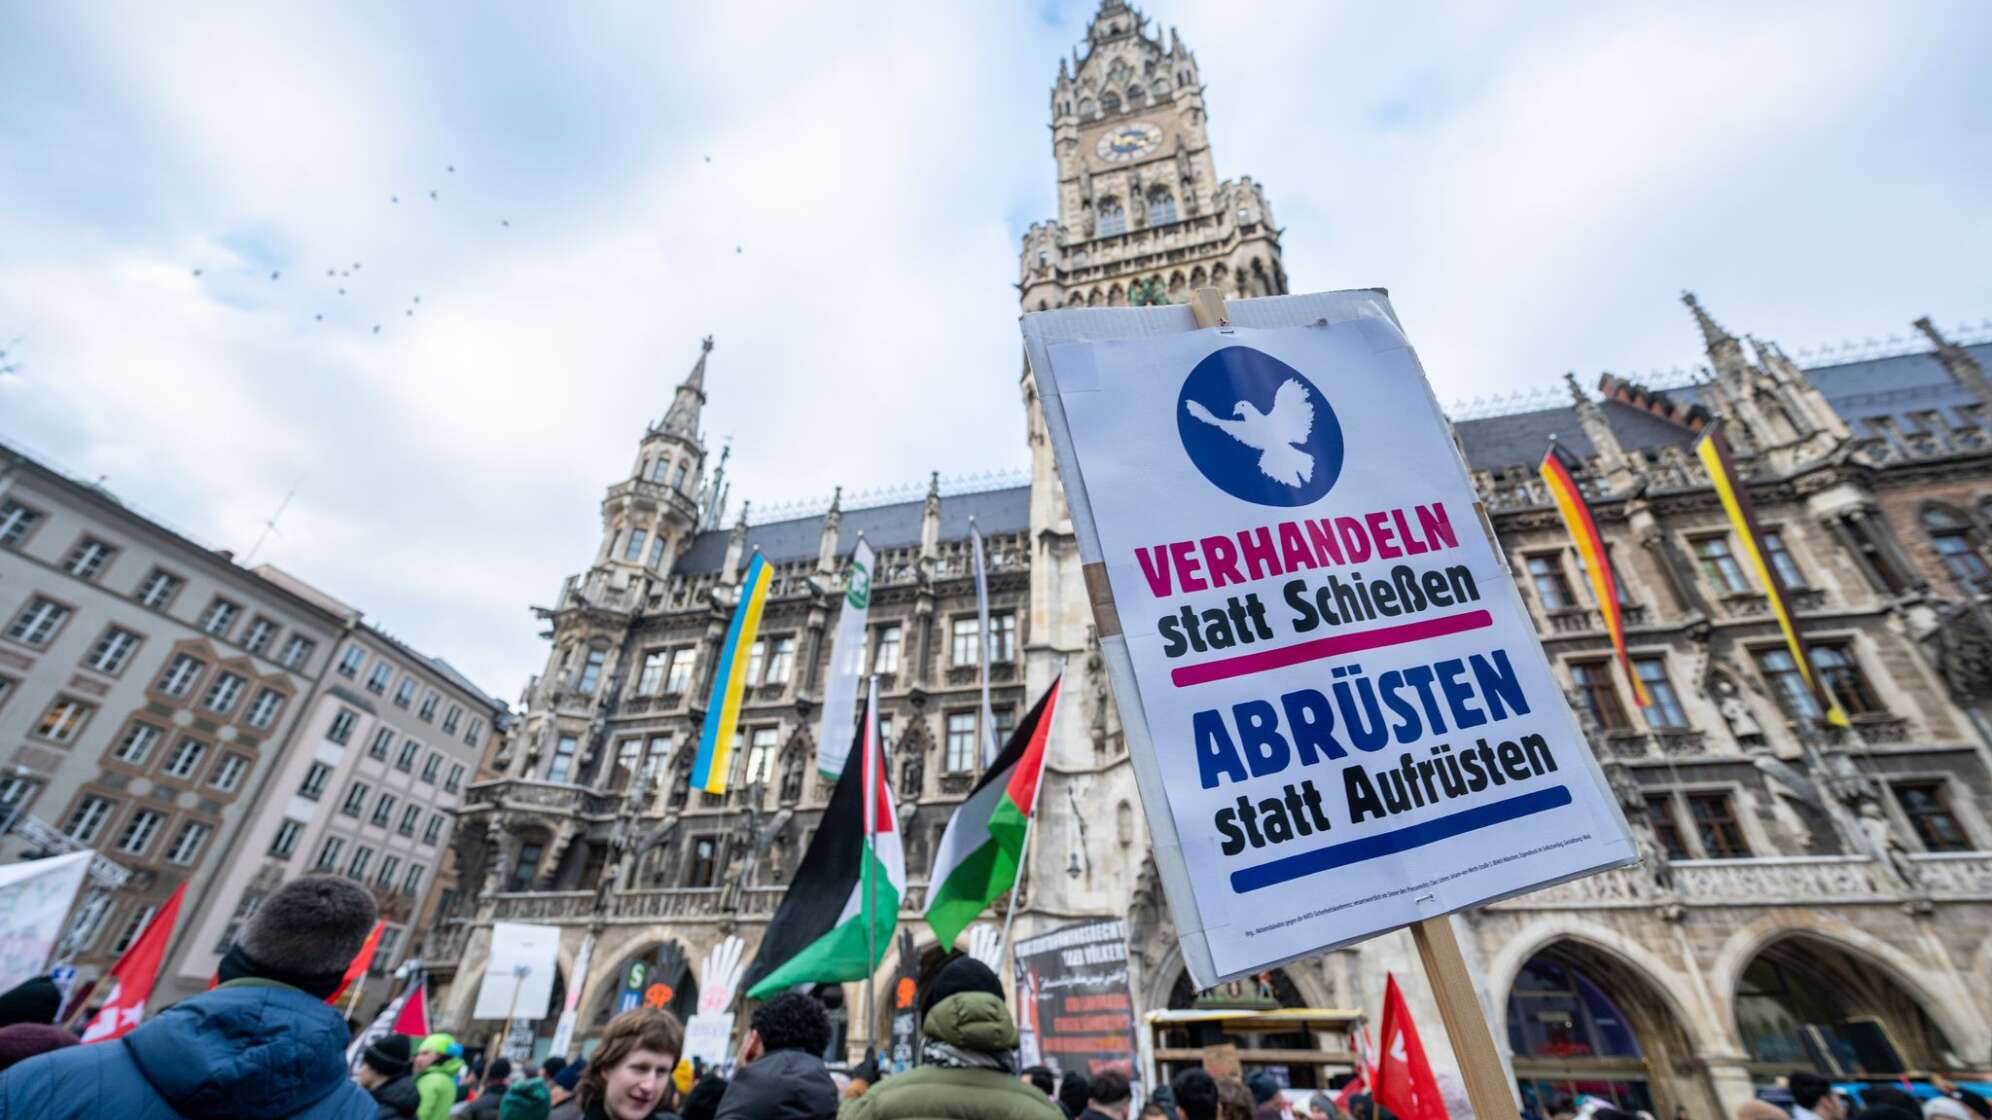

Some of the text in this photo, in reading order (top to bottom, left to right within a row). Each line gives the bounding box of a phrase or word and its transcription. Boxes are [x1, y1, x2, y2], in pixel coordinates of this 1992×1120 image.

[1134, 502, 1459, 598] VERHANDELN
[1157, 564, 1481, 660] statt Schießen
[1192, 648, 1532, 790] ABRÜSTEN
[1214, 732, 1559, 857] statt Aufrüsten
[629, 962, 645, 989] S
